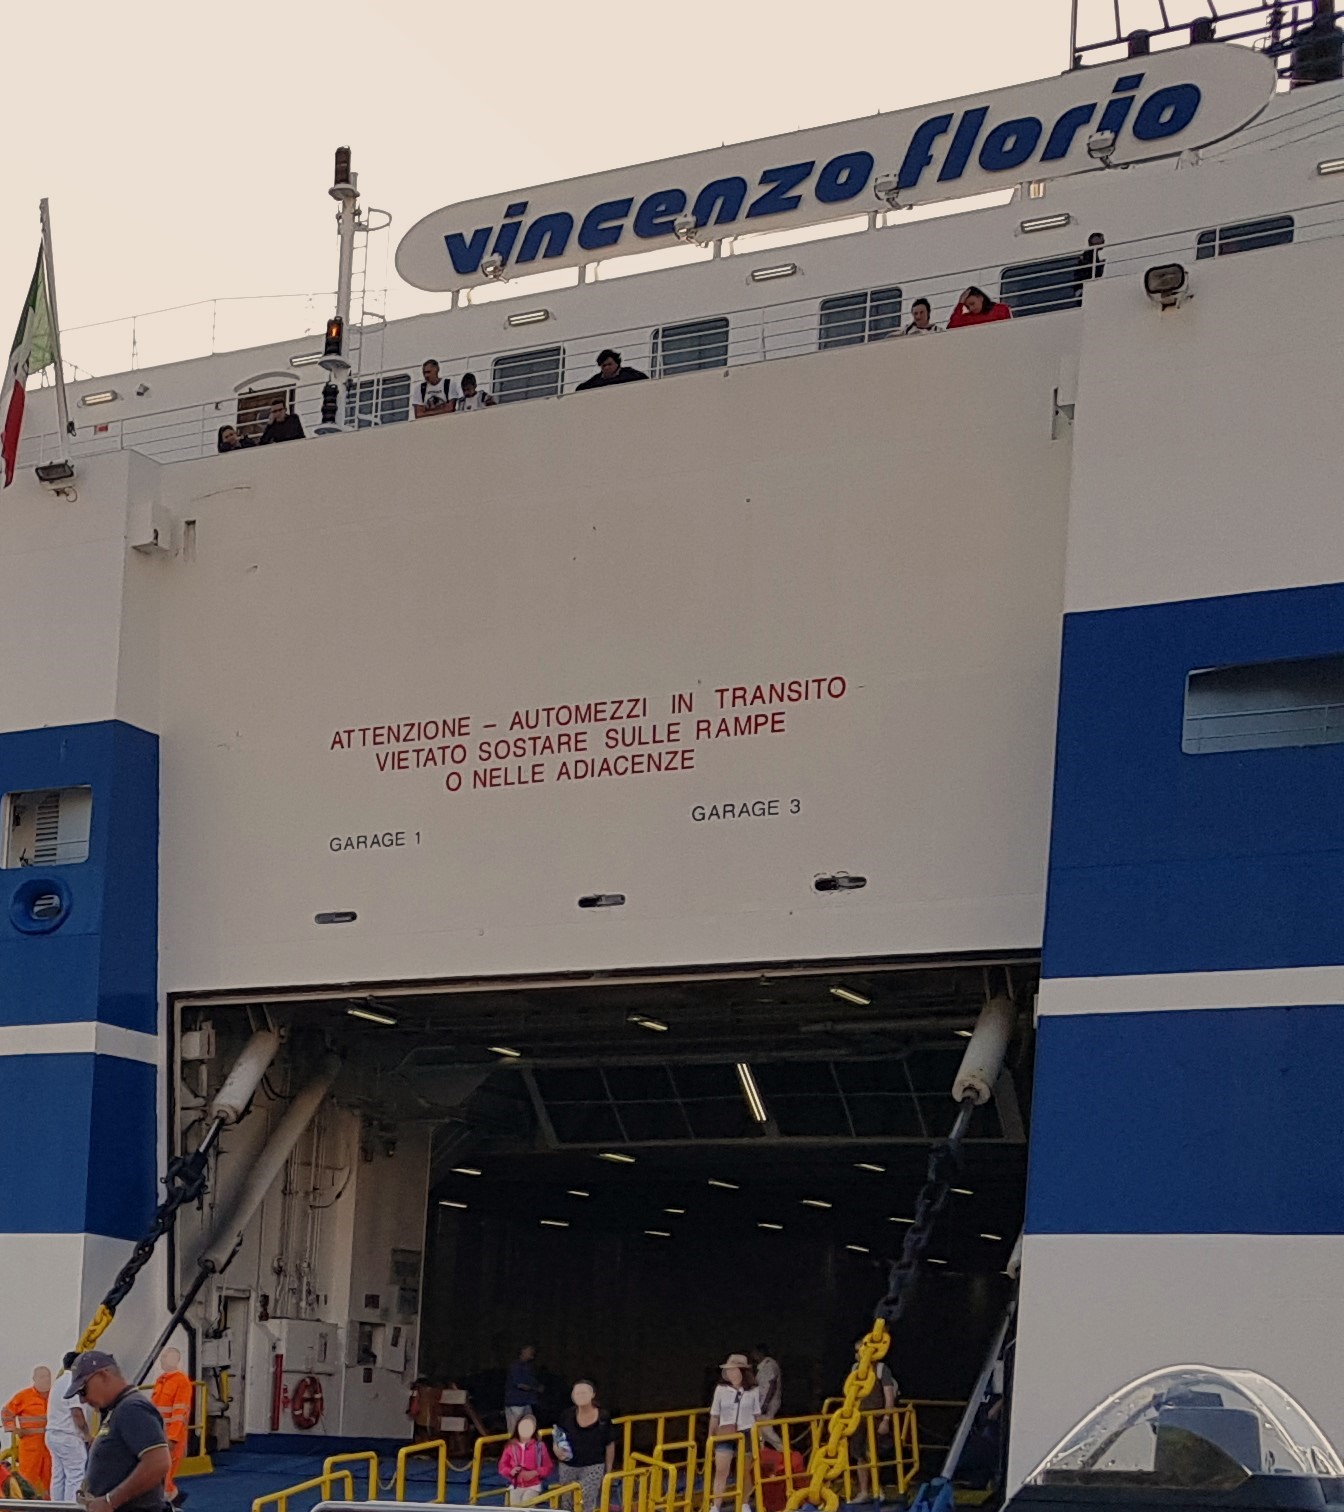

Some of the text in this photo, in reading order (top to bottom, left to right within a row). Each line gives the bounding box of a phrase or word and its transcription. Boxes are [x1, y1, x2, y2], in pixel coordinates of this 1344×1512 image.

[443, 74, 1202, 275] vincenzo florio
[329, 716, 471, 751] ATTENZIONE
[508, 696, 648, 732] AUTOMEZZI
[670, 692, 695, 715] IN
[714, 675, 848, 709] TRANSITO
[375, 710, 787, 773] VIETATO SOSTARE SULLE RAMPE
[445, 748, 696, 793] O NELLE ADIACENZE
[691, 798, 802, 822] GARAGE 3
[329, 831, 421, 853] GARAGE 1
